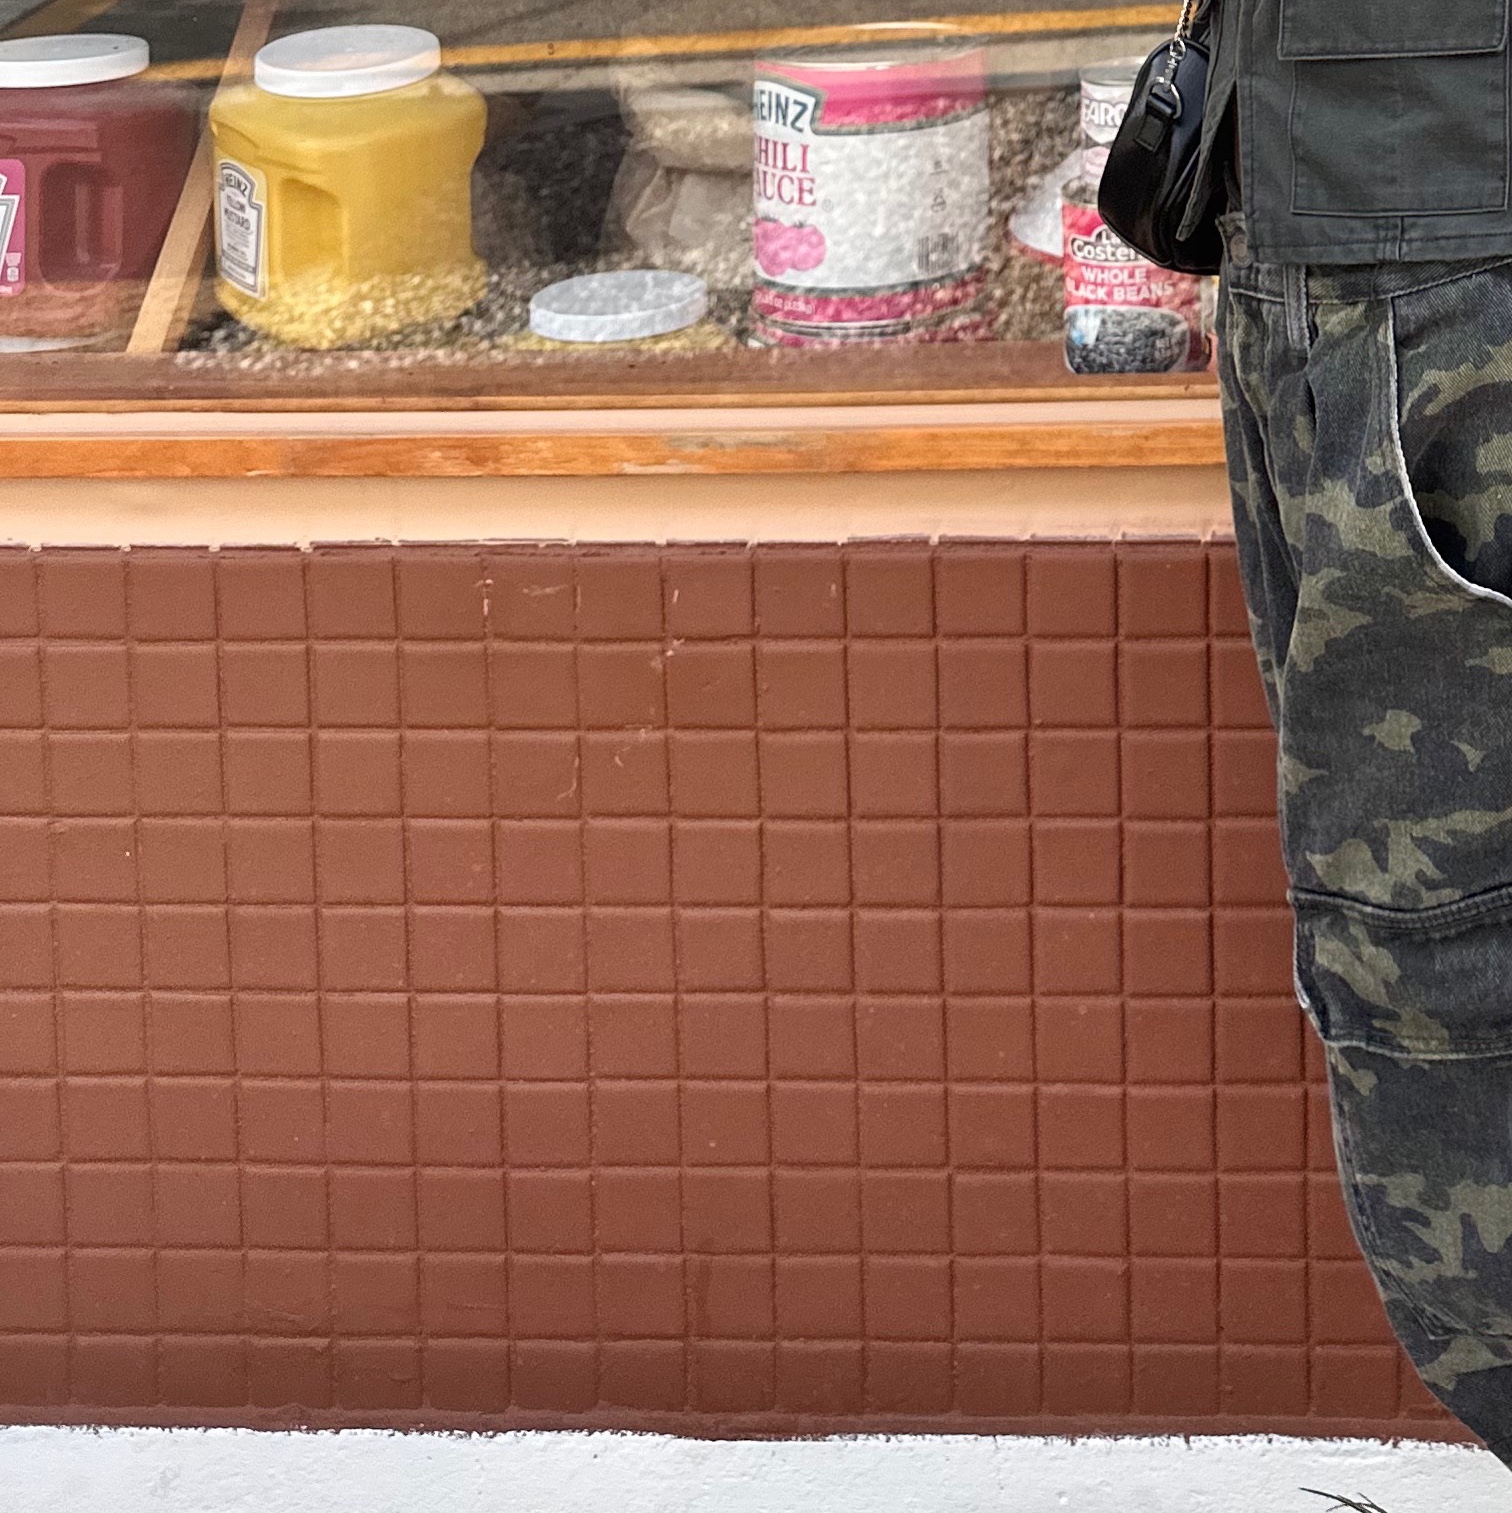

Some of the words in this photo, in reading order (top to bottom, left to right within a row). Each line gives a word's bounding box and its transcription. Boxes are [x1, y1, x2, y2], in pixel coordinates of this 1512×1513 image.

[755, 136, 811, 174] HILI
[1081, 265, 1148, 283] WHOLE
[1112, 280, 1174, 302] BEANS
